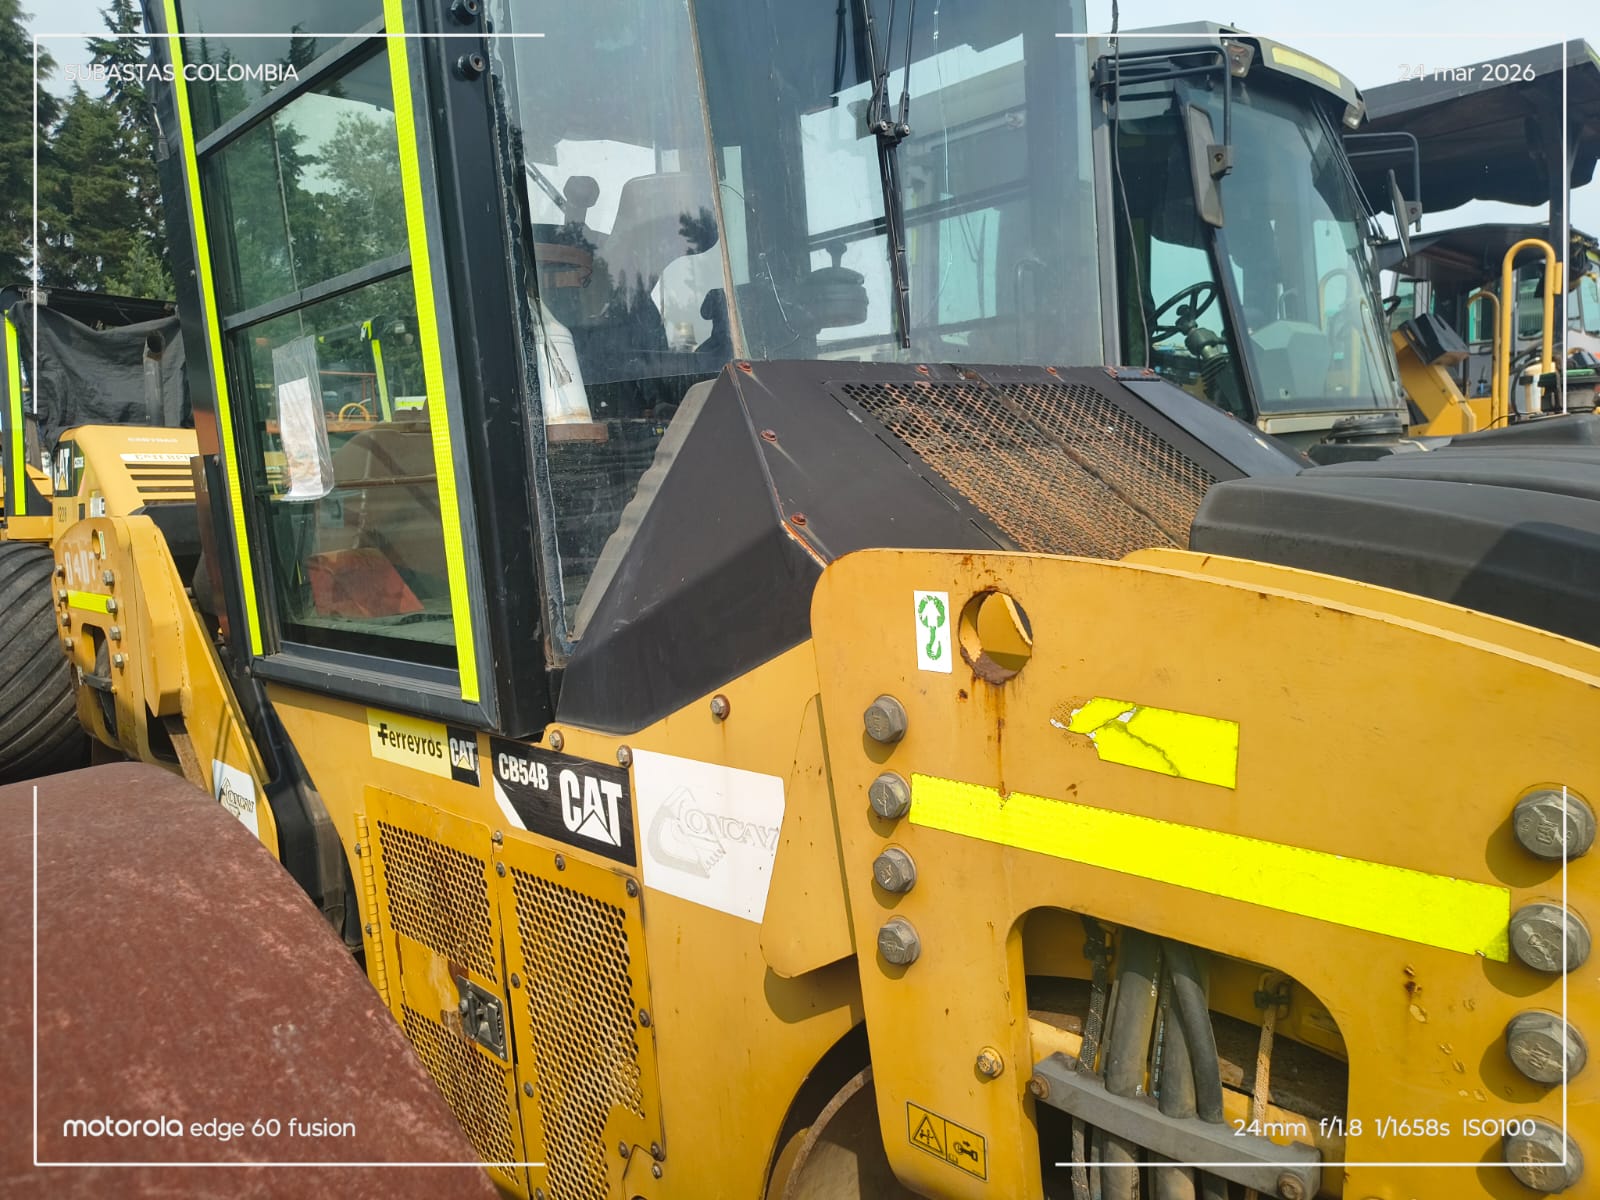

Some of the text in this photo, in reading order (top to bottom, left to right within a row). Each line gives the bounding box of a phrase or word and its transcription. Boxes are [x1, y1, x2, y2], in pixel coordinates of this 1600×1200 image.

[450, 736, 476, 771] CAT
[498, 752, 549, 791] CB54B
[559, 768, 623, 847] CAT
